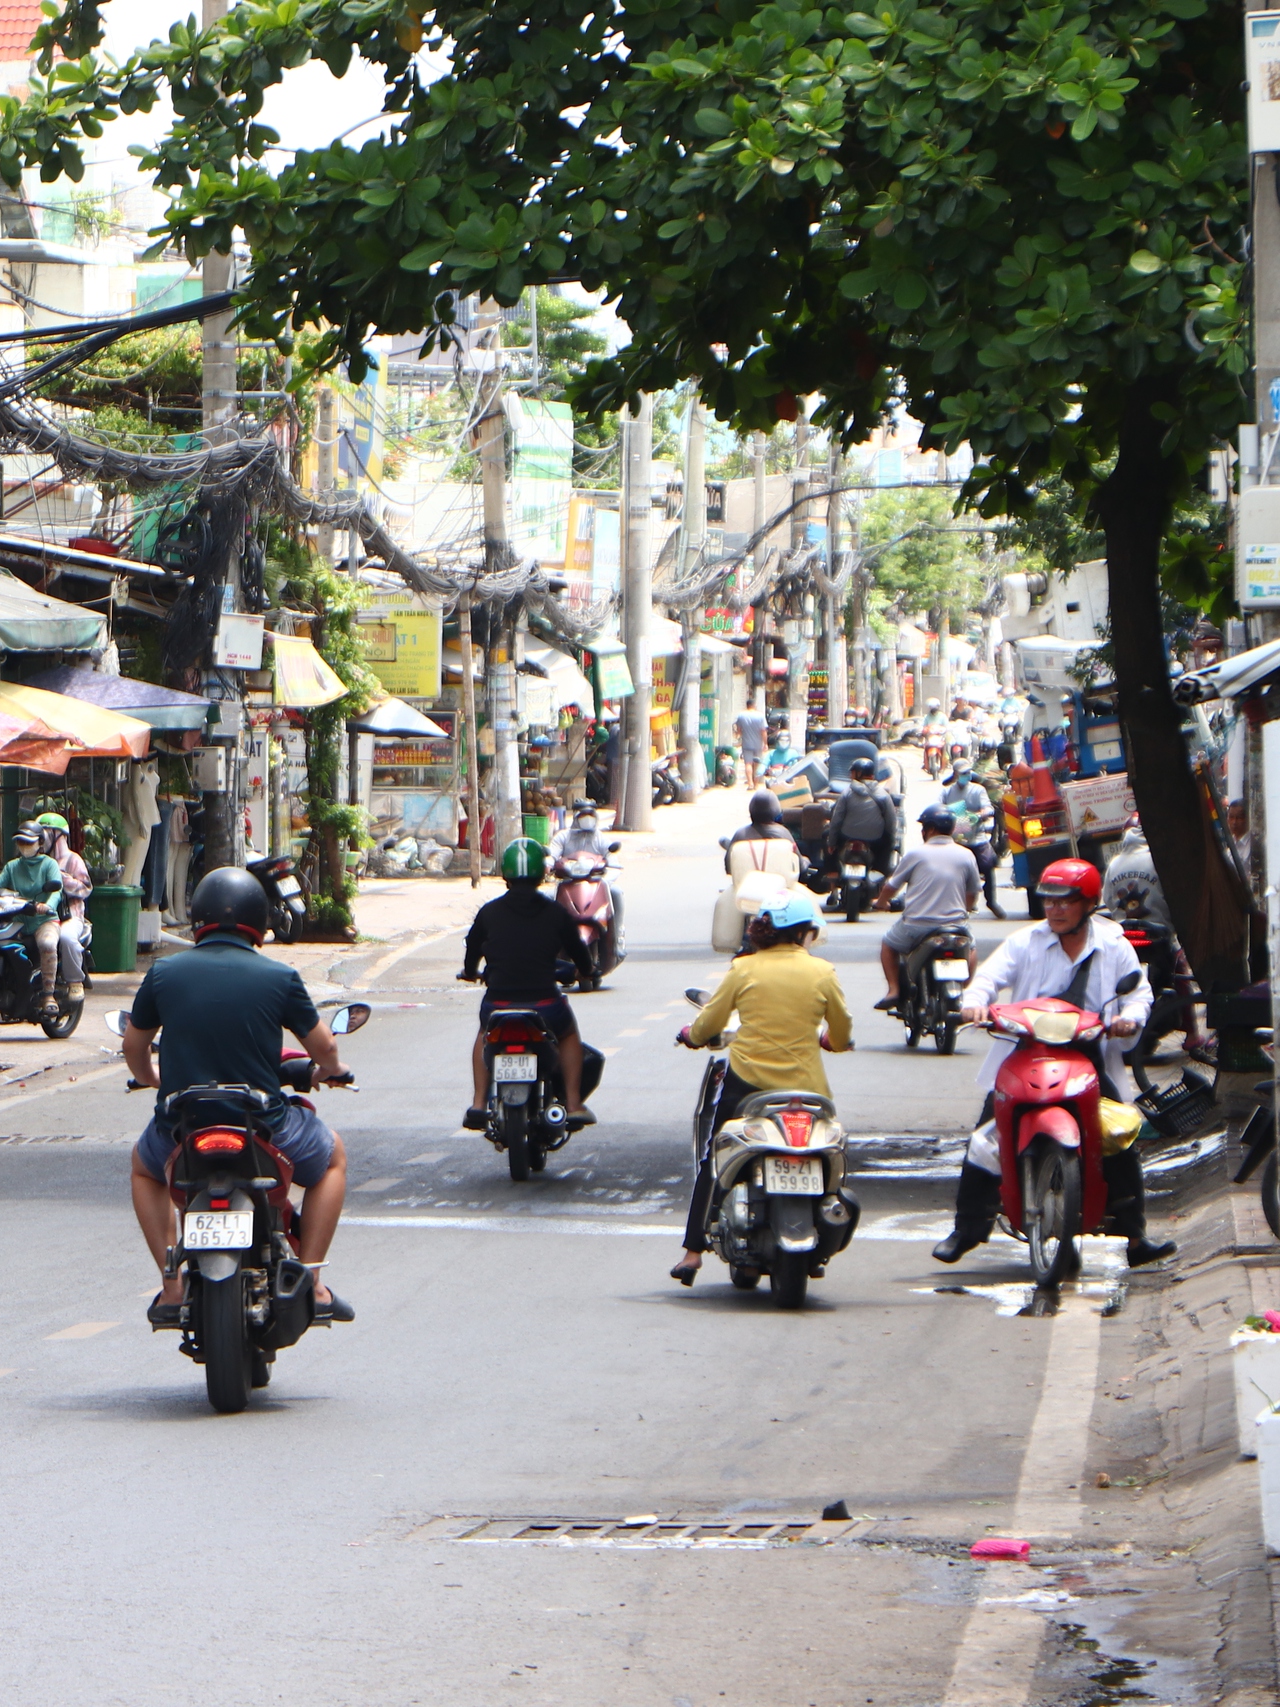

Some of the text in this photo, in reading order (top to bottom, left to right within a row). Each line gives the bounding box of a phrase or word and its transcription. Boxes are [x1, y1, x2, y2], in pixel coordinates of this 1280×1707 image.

[1111, 870, 1158, 886] MIKEBEAR
[775, 1160, 812, 1175] 59-Z1
[771, 1175, 820, 1191] 159.98
[196, 1215, 239, 1230] 62-L1
[189, 1231, 248, 1247] 965.73
